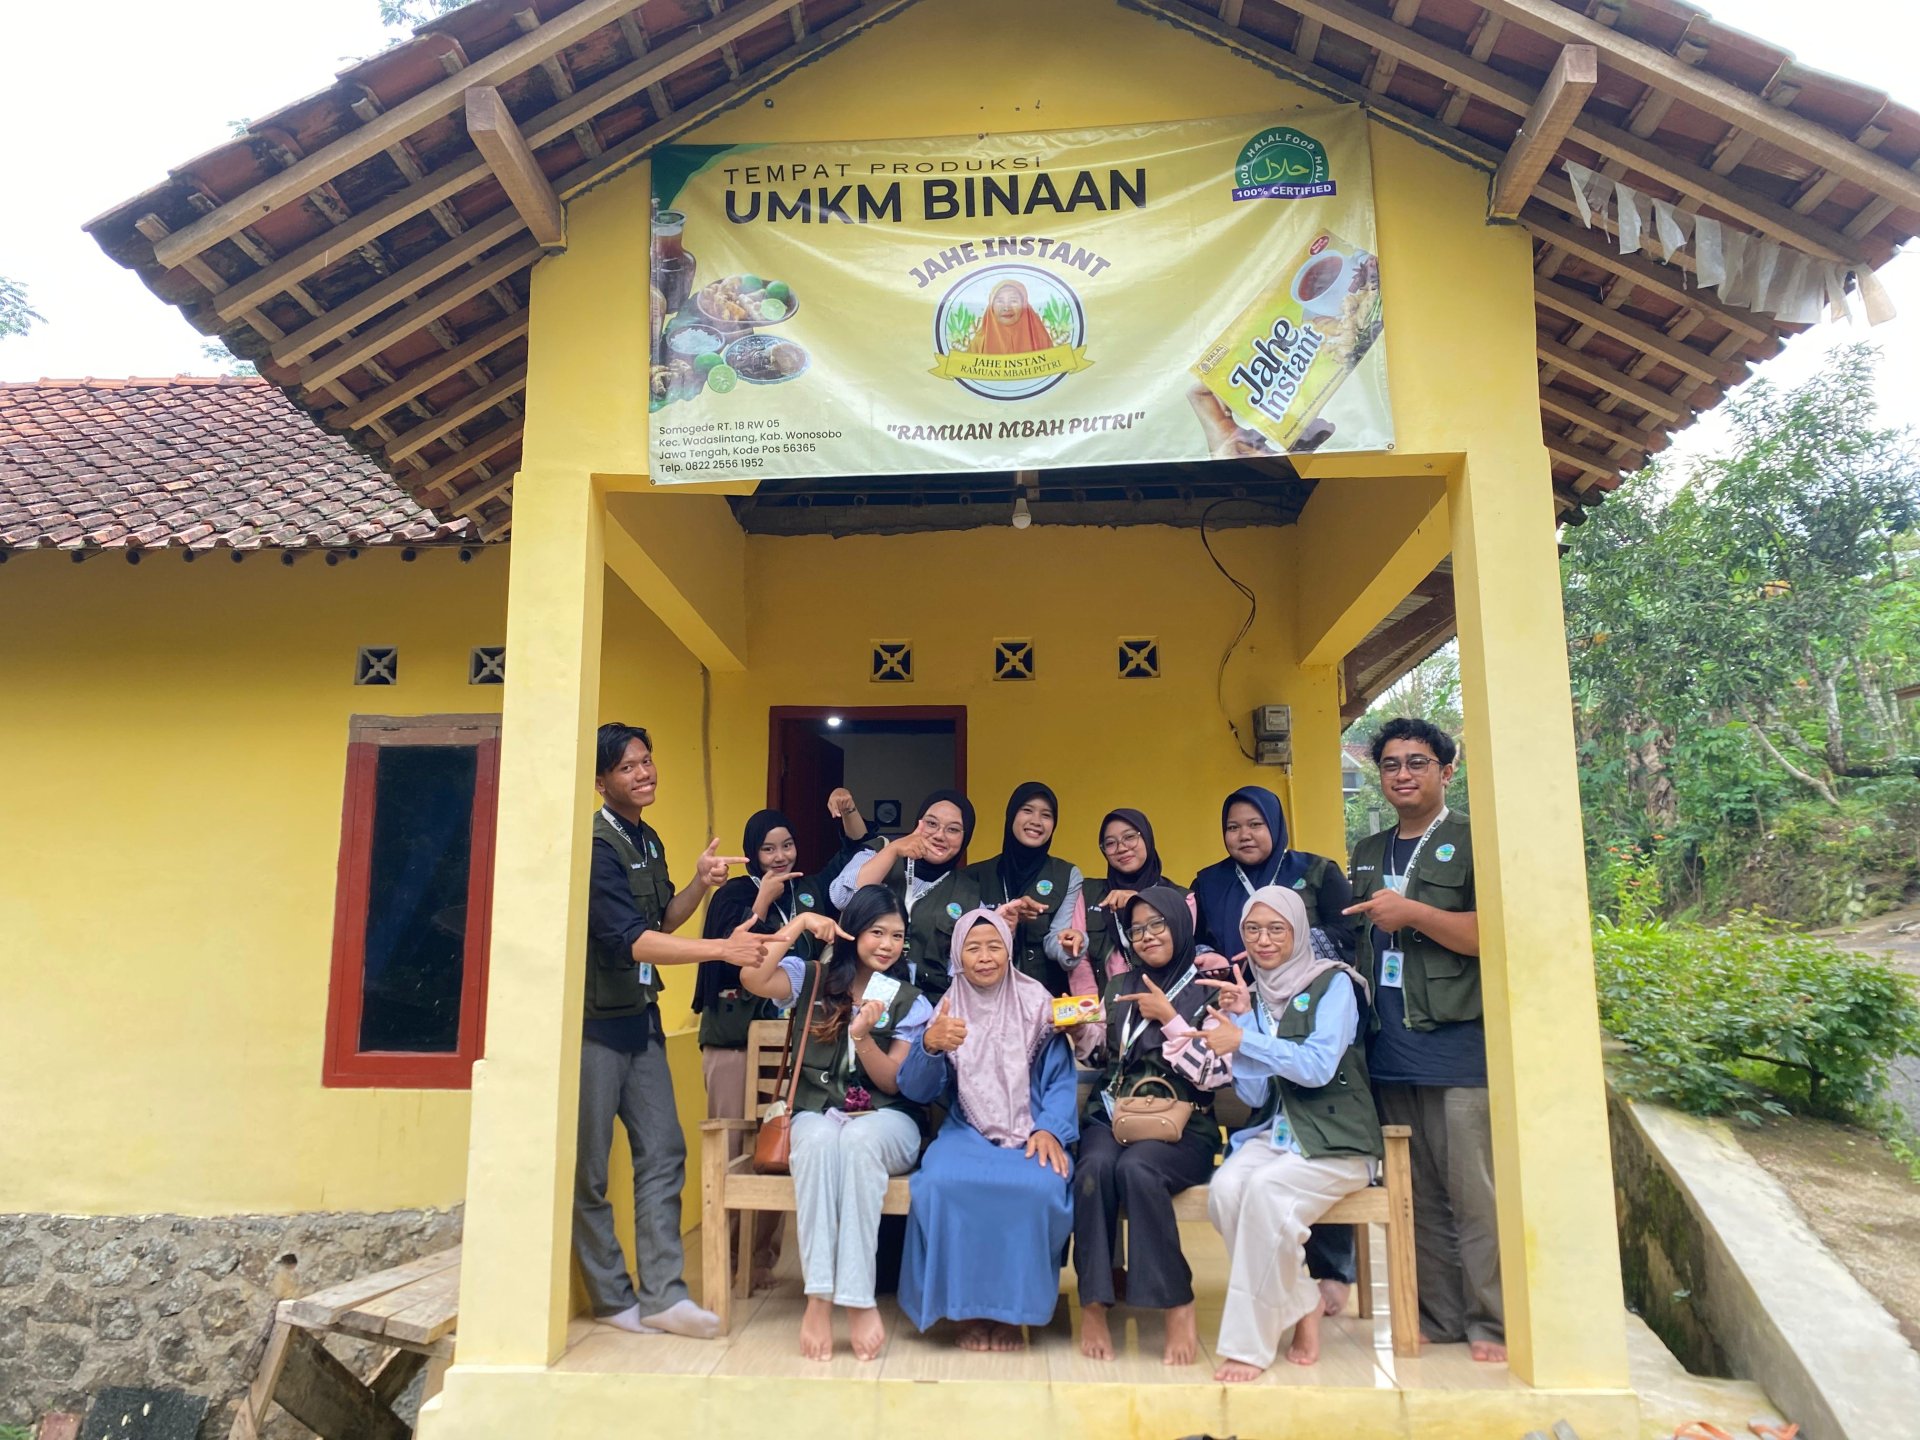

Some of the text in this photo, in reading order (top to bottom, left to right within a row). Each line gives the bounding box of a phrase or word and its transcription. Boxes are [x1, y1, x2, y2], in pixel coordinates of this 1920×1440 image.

[1247, 133, 1315, 158] HALAL FOOD
[723, 156, 1041, 185] TEMPAT PRODUKSI
[725, 168, 1147, 225] UMKM BINAAN
[1236, 184, 1332, 198] 100% CERTIFIED
[908, 235, 1112, 289] JAHE INSTANT
[960, 359, 1062, 377] RAMUAN MBAH PUTRI
[972, 353, 1047, 369] JAHE INSTAN
[1231, 319, 1299, 405] Jahe
[1258, 324, 1323, 421] Instant
[659, 419, 780, 435] Somogede RT. 18 RW 05
[886, 411, 1146, 441] "RAMUAN MBAH PUTRI"
[659, 430, 842, 447] Kec. Wadaslintang, Kab. Wonosobo
[659, 443, 816, 460] Jawa Tengah, Kode Pos 56365
[660, 458, 764, 474] Telp. 0822 2556 1952
